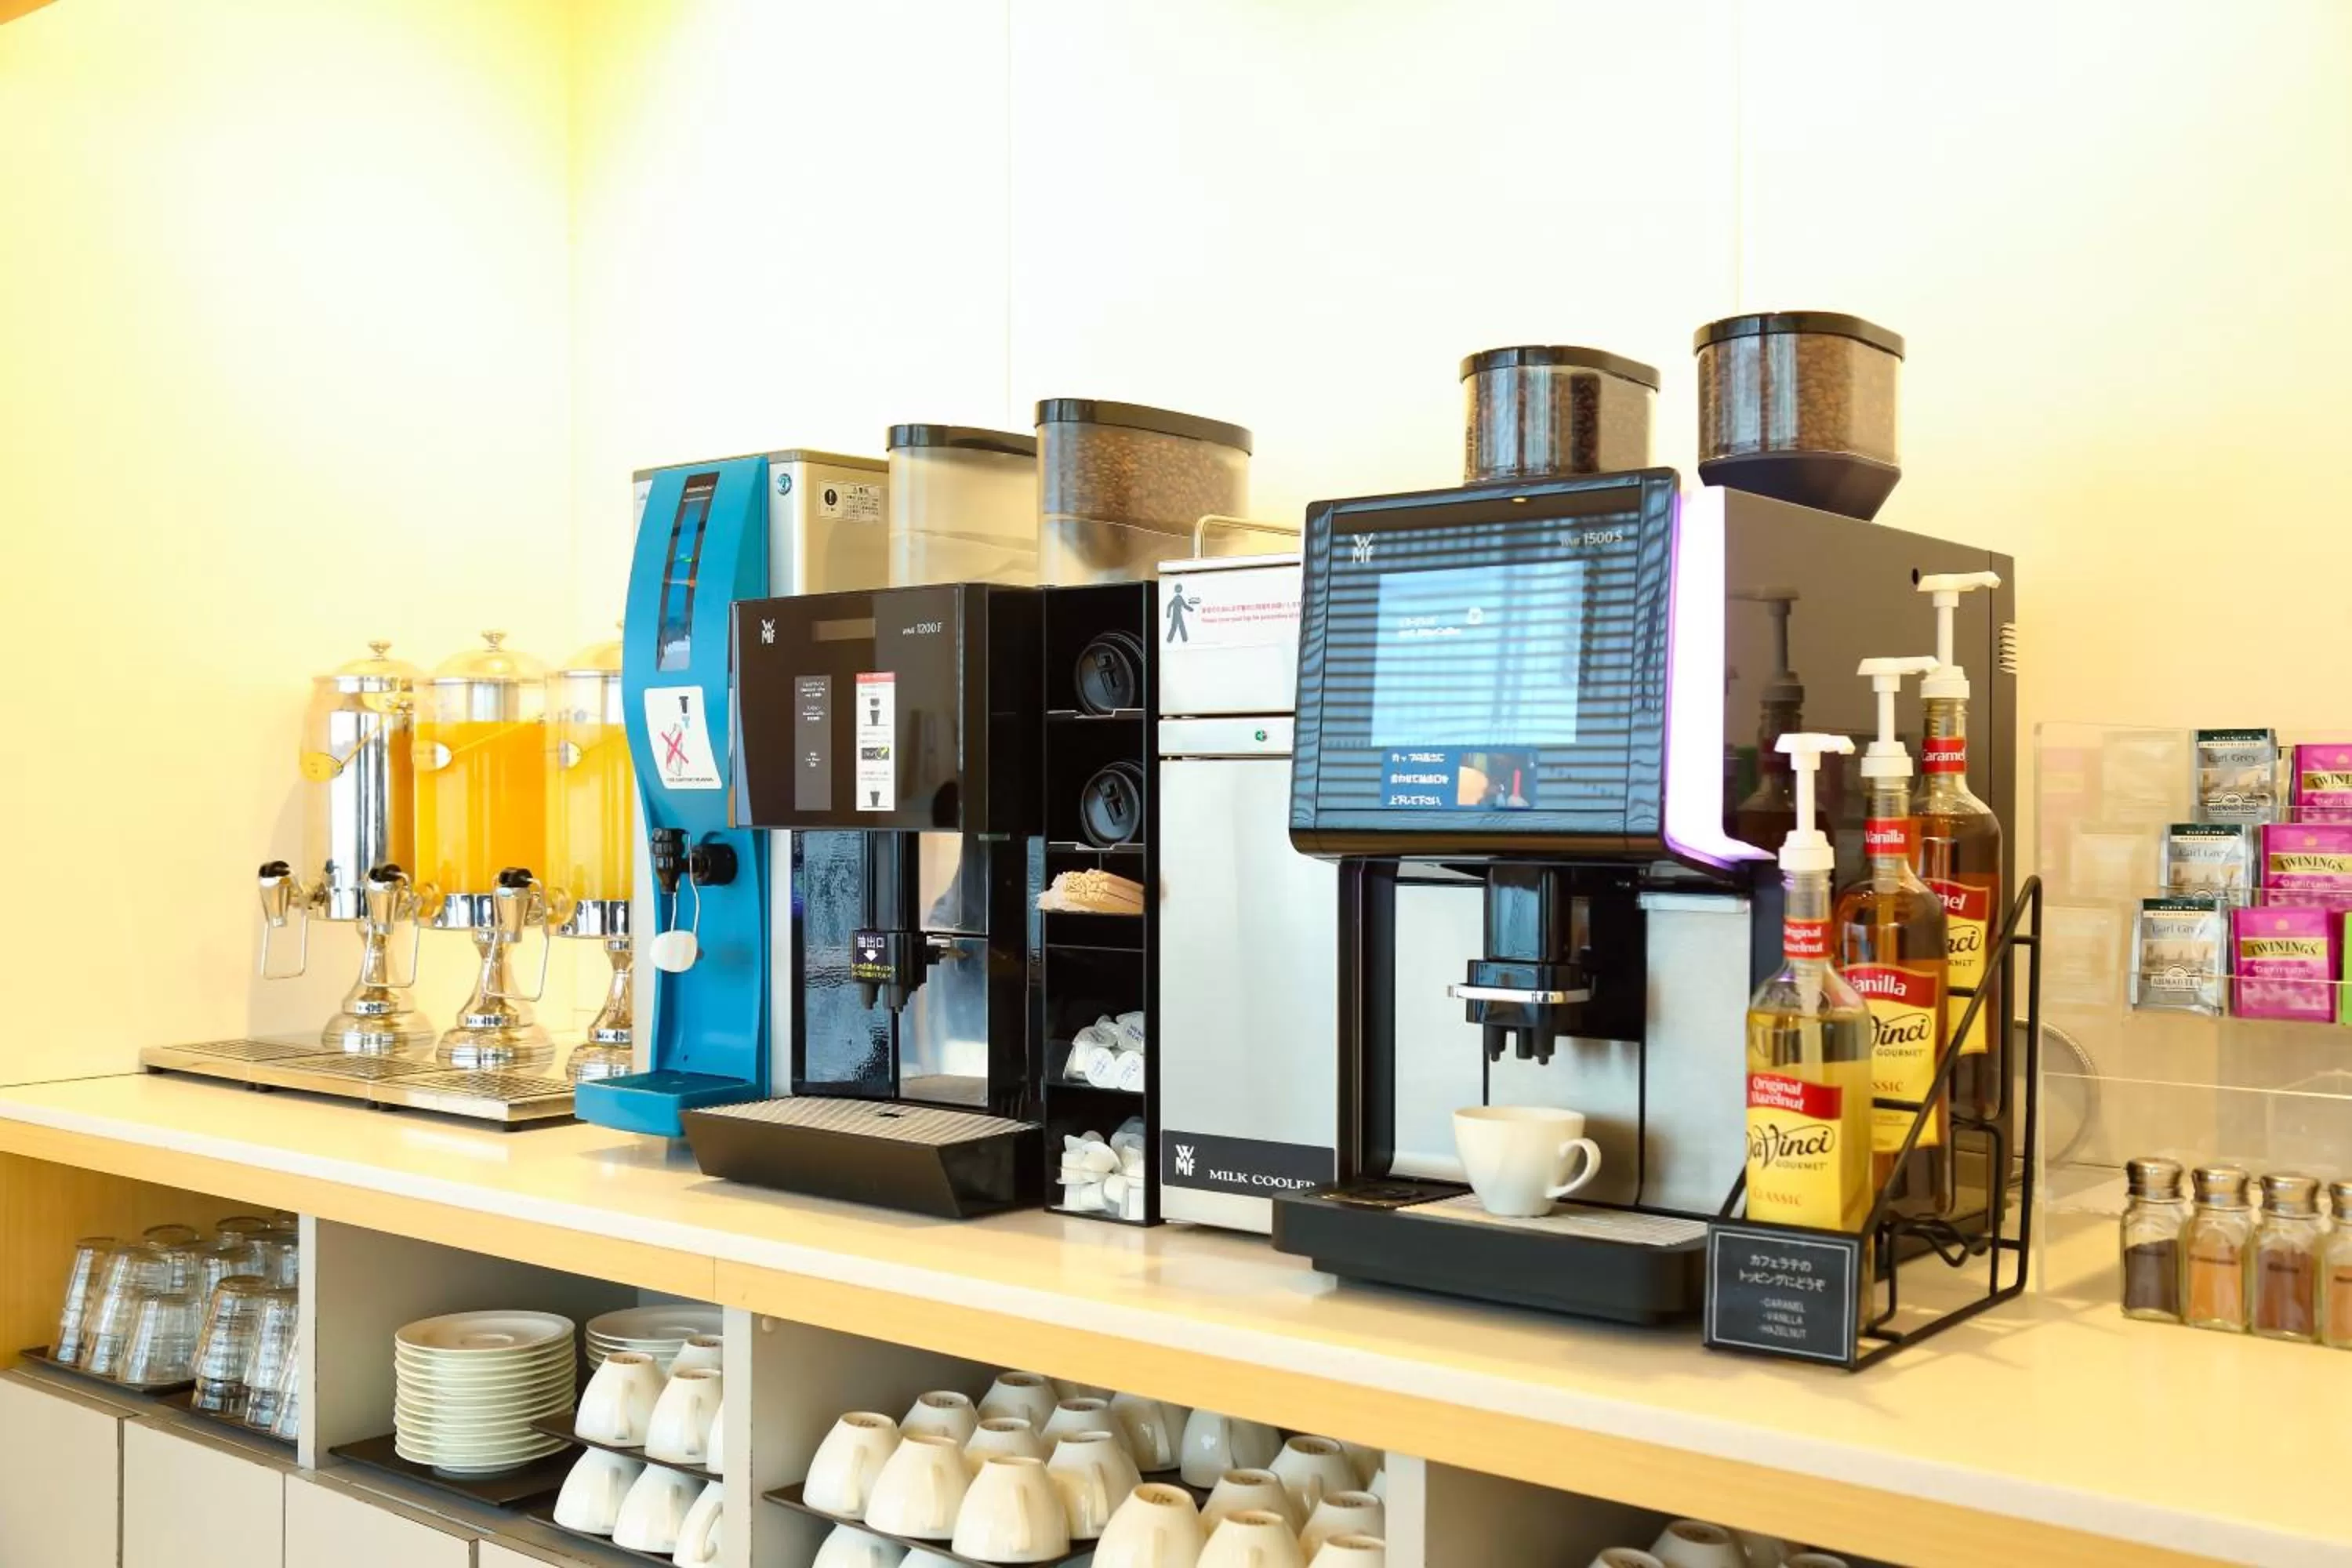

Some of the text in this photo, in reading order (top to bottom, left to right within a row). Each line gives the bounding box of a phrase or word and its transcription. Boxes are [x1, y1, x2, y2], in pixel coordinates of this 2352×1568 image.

[1581, 531, 1613, 546] 1500
[2277, 855, 2345, 871] TWININGS
[2249, 940, 2319, 956] TWININGS
[1753, 1076, 1802, 1096] Original
[1751, 1091, 1804, 1111] Hazelnut
[1776, 1160, 1827, 1171] GOURMET
[1209, 1169, 1248, 1184] MILK
[1753, 1186, 1802, 1206] CLASSIC
